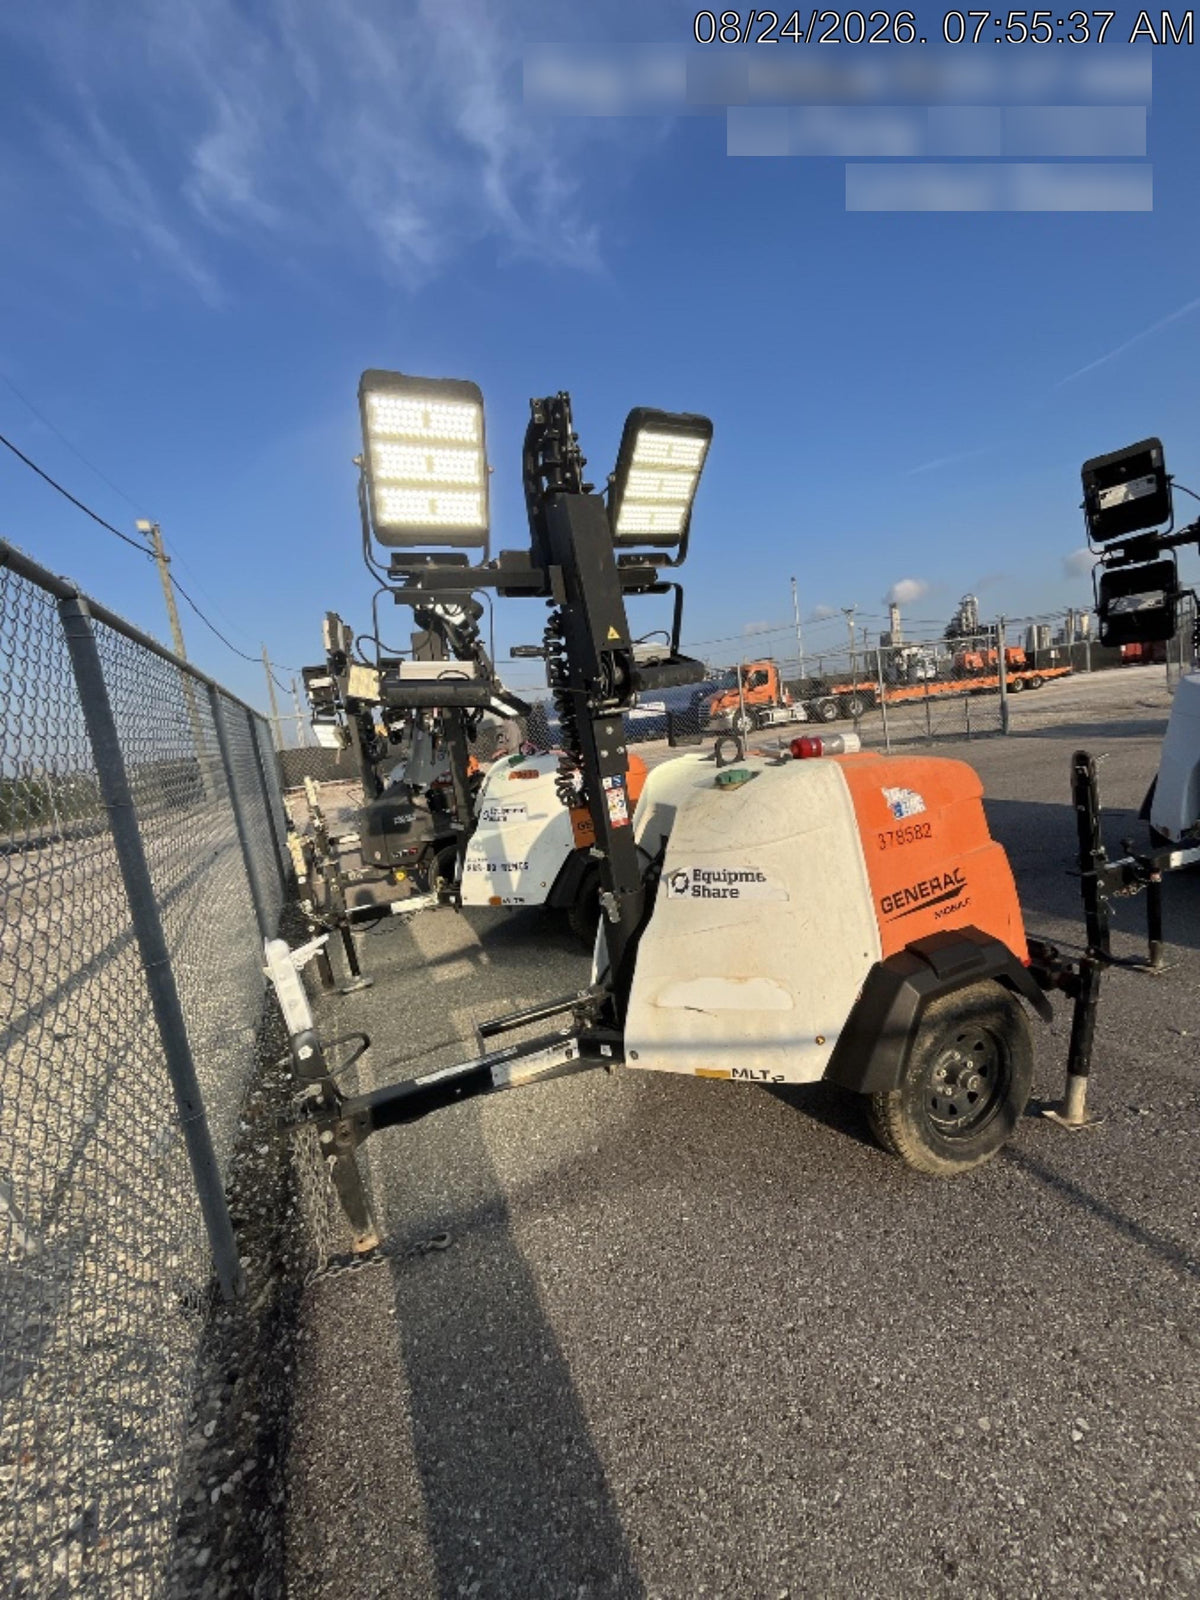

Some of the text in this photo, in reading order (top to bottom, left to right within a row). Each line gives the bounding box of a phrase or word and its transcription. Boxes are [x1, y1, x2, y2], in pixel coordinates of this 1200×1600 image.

[877, 822, 932, 850] 378582
[691, 885, 740, 899] Share
[880, 867, 966, 914] GENERAC
